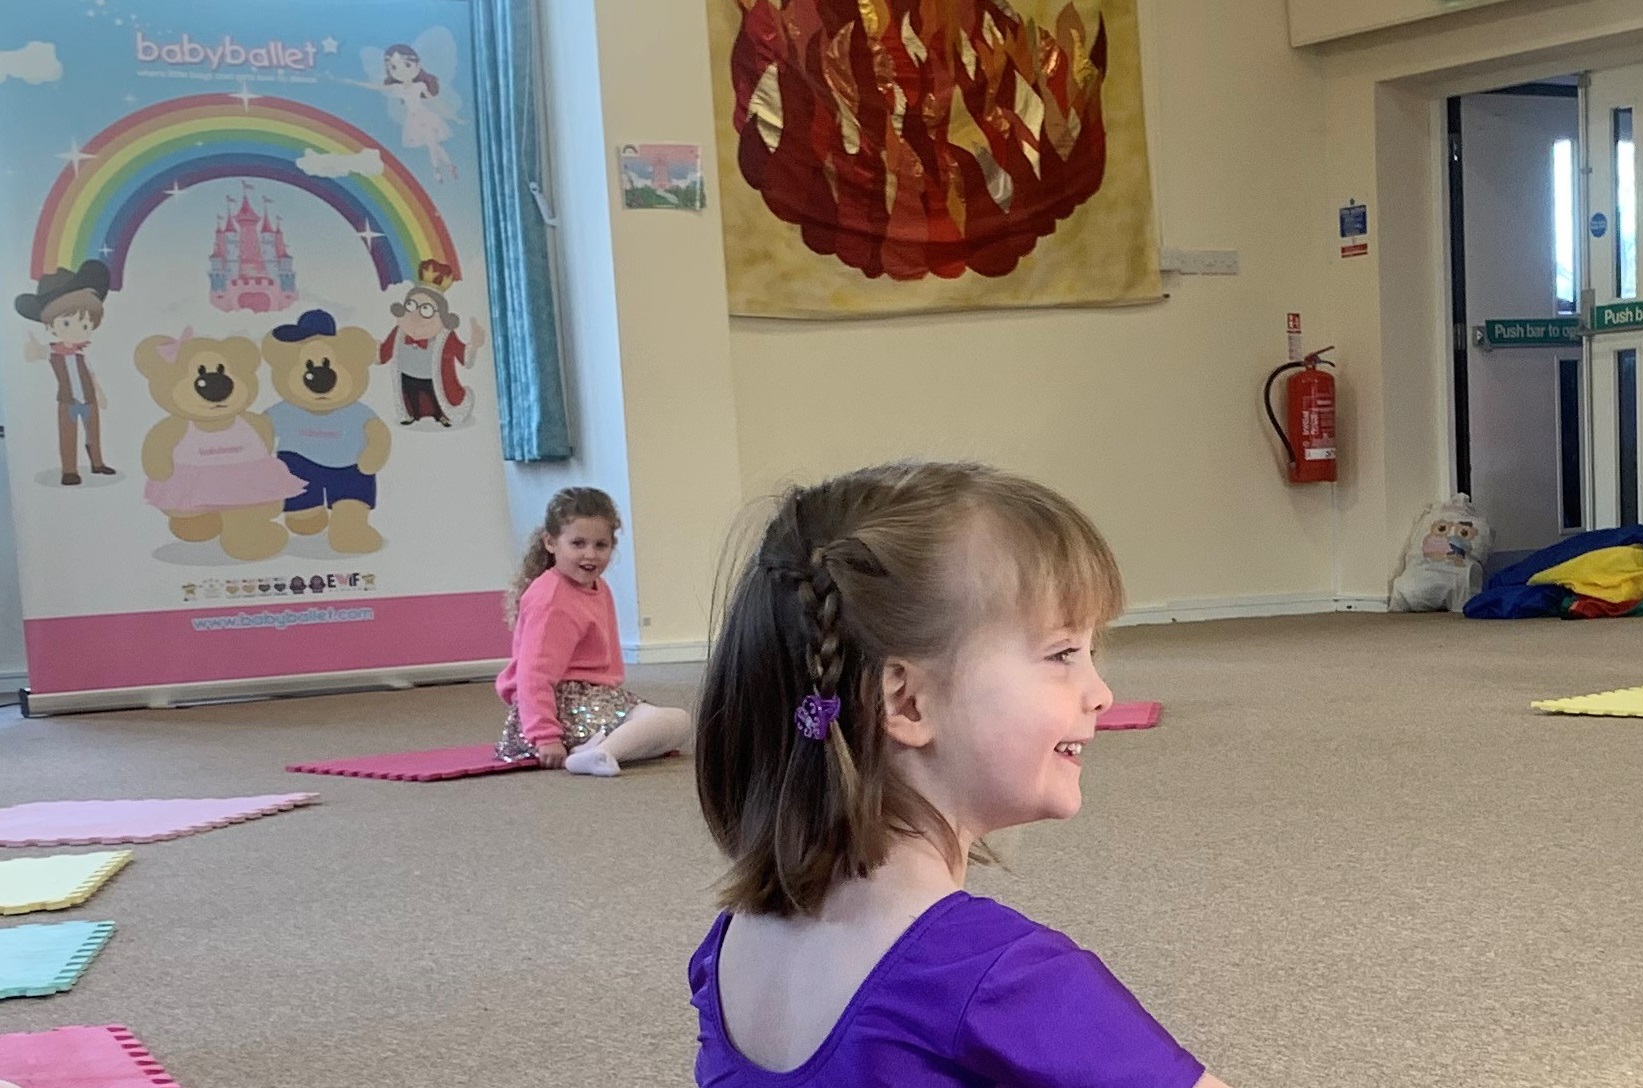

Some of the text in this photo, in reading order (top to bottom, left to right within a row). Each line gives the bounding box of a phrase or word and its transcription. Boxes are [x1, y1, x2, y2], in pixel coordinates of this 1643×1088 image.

[135, 32, 317, 69] babyballet
[1604, 305, 1633, 324] Push
[1494, 323, 1579, 341] Push bar to op
[193, 607, 374, 629] www.babyballet.com
